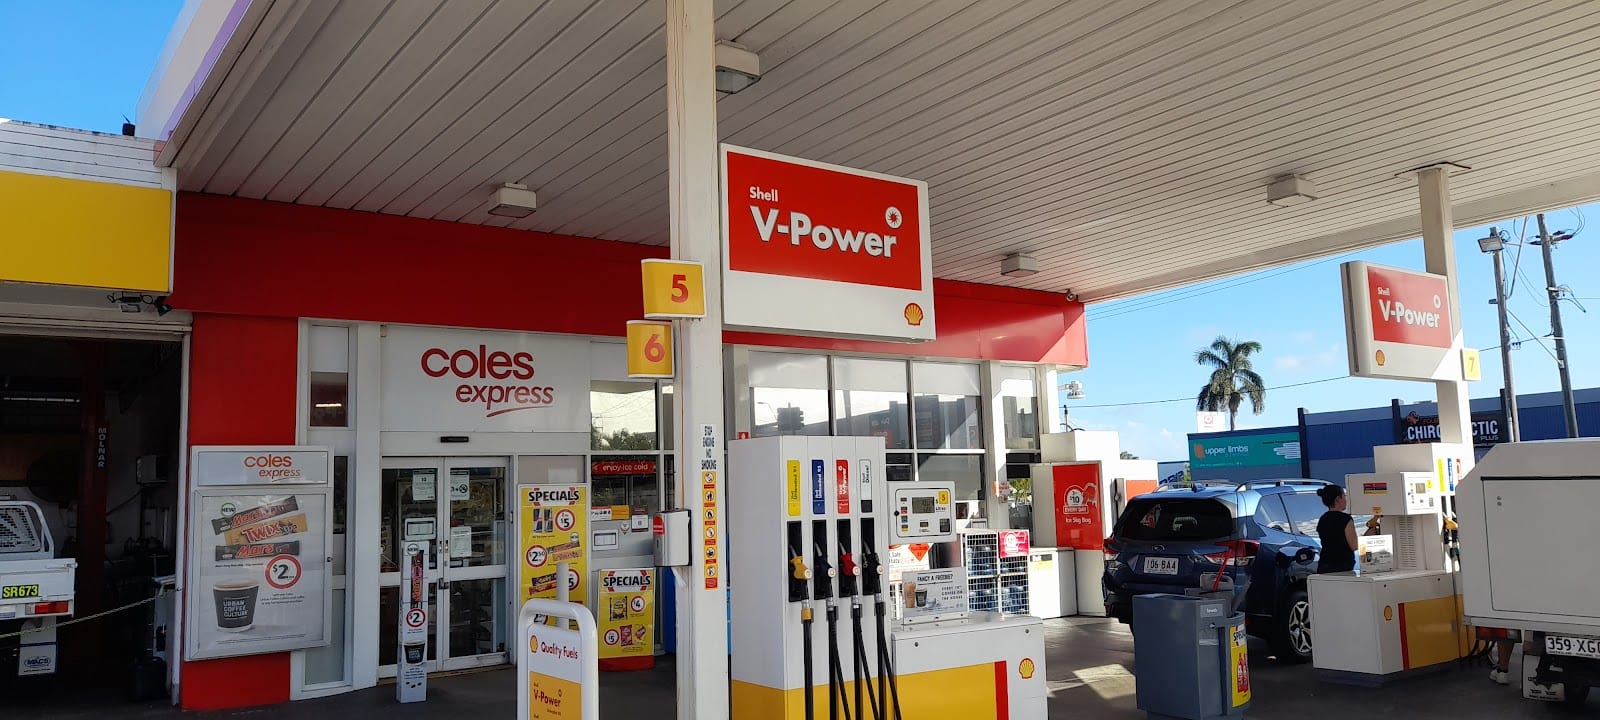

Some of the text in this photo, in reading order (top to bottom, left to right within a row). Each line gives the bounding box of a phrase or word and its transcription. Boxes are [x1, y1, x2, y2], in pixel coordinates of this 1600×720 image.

[749, 186, 779, 202] Shell
[749, 205, 897, 258] V-Power
[670, 274, 689, 304] 5
[1377, 286, 1391, 297] Shell
[1378, 298, 1440, 328] V-Power
[643, 333, 666, 363] 6
[420, 344, 535, 380] coles
[1468, 356, 1476, 373] 7
[455, 384, 554, 411] express
[704, 425, 713, 437] STOP
[97, 427, 107, 468] MOLNAR
[702, 436, 715, 448] ENGINE
[705, 449, 712, 459] NO
[1204, 446, 1227, 456] upper
[1228, 444, 1249, 453] limbs
[243, 453, 293, 468] coles
[602, 464, 621, 472] enjoy
[633, 462, 649, 471] cold
[701, 459, 717, 470] SMOKING
[258, 468, 301, 479] express
[528, 489, 580, 502] SPECIALS
[1082, 516, 1092, 525] Bag
[241, 522, 280, 543] TWIX
[235, 543, 275, 559] Mars
[272, 563, 289, 579] $2
[603, 575, 651, 587] SPECIALS
[3, 584, 39, 598] SR673
[223, 599, 246, 607] URBAN
[223, 610, 249, 618] CULTURE
[540, 641, 579, 660] Quality Fuels
[533, 688, 561, 708] V-Power
